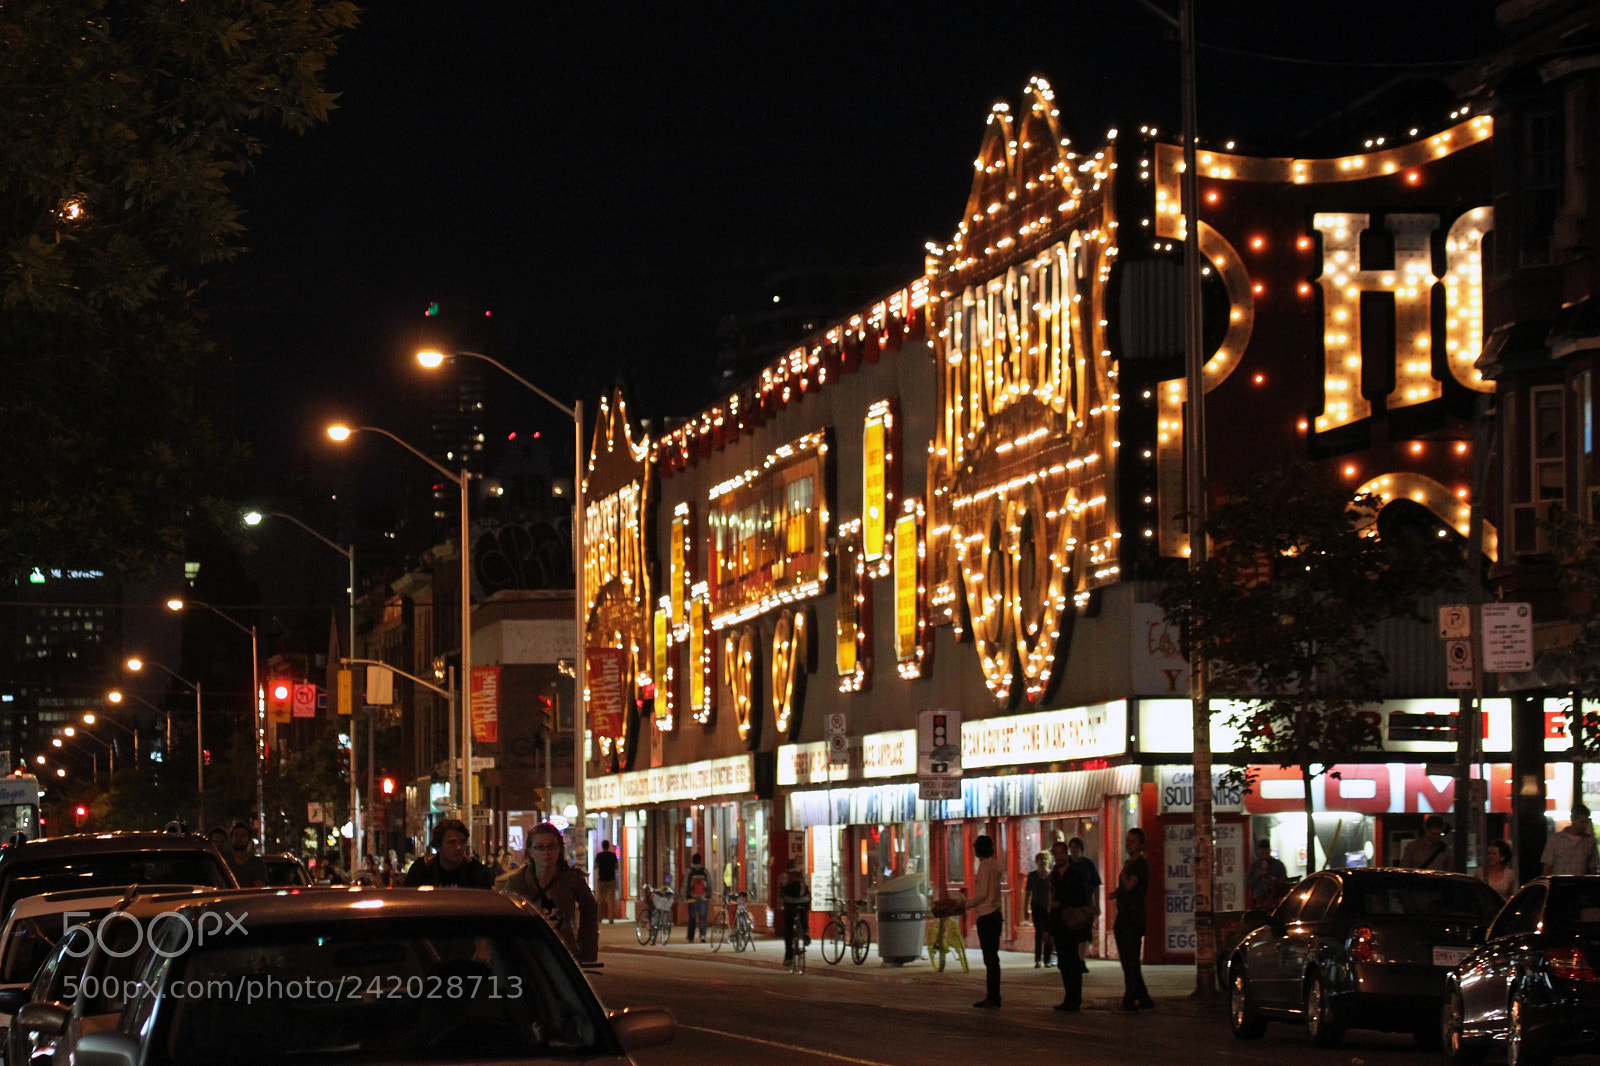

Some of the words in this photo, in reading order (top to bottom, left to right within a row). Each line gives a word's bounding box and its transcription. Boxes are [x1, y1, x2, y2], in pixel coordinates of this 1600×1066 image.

[482, 674, 497, 722] MIRVISH
[590, 677, 610, 733] VILLAGE
[602, 658, 622, 714] MIRVISH
[471, 690, 487, 737] VILLAGE
[1165, 786, 1241, 806] SOUNIRS
[1167, 864, 1192, 878] MIL
[1168, 934, 1196, 949] EGG
